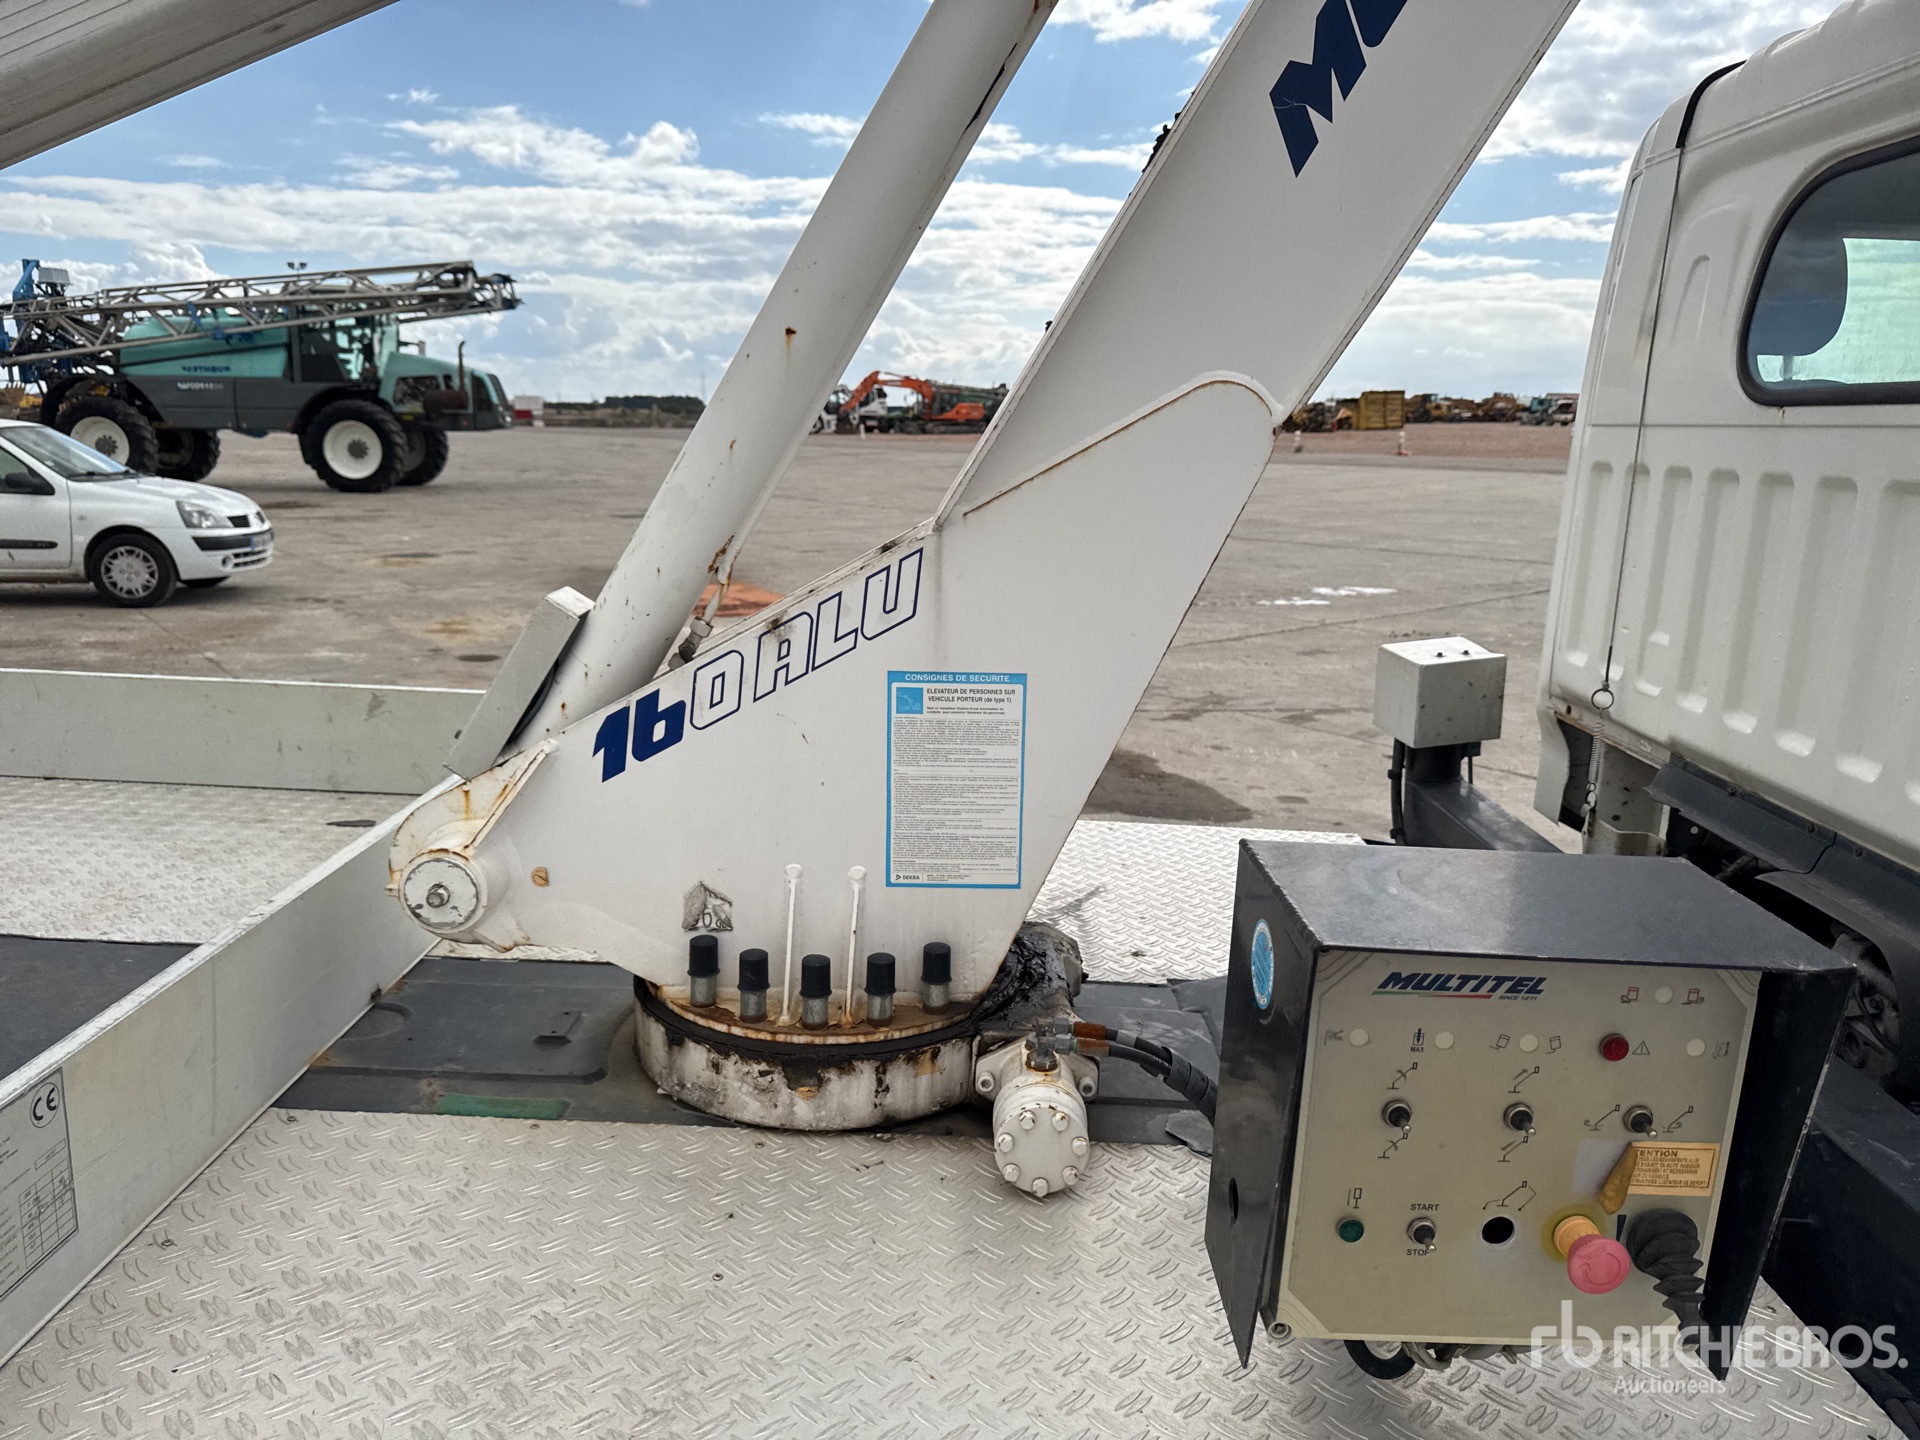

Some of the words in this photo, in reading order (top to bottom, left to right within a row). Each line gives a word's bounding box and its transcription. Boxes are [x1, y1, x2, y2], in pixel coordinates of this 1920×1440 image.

[754, 546, 924, 703] ALU
[905, 674, 954, 682] CONSIGNES
[970, 674, 1010, 682] SECURITE
[1376, 972, 1548, 994] MULTITEL
[32, 1087, 57, 1122] CE
